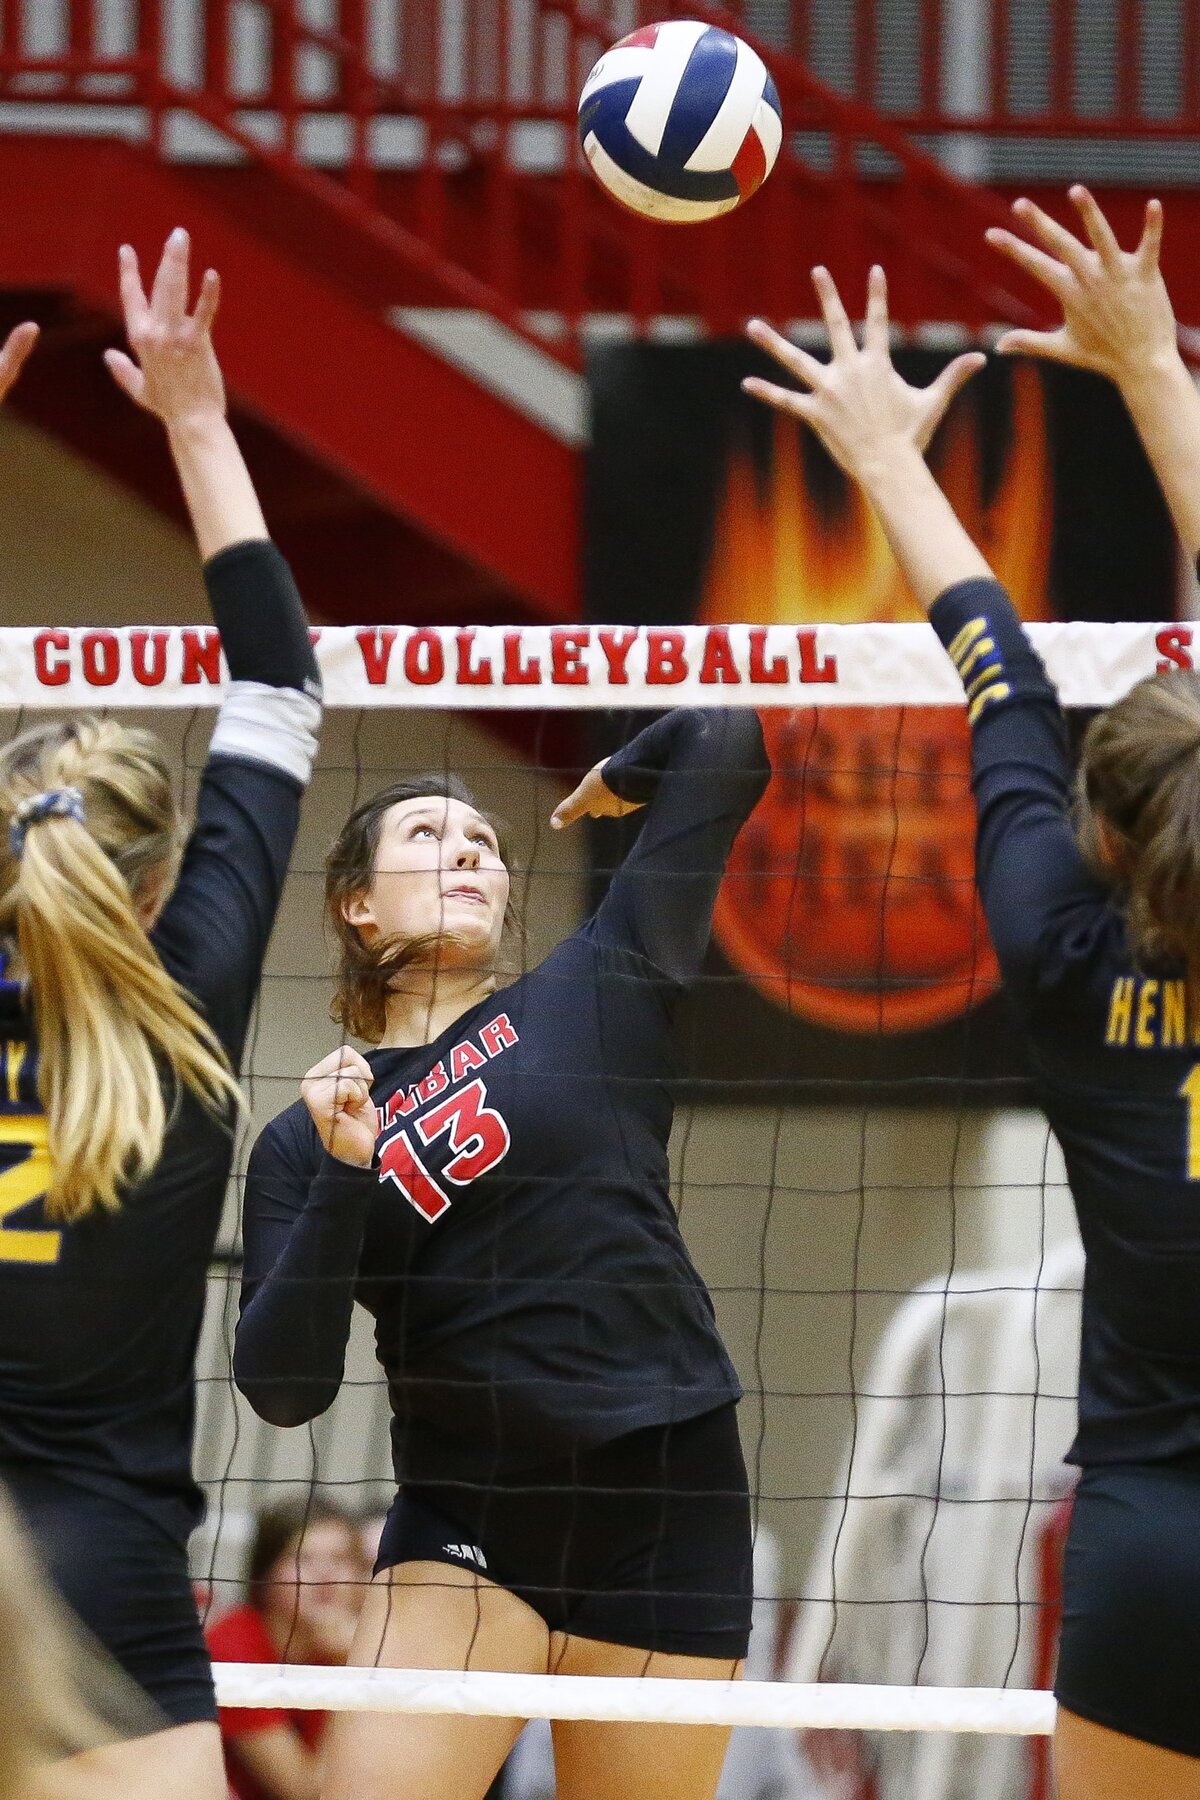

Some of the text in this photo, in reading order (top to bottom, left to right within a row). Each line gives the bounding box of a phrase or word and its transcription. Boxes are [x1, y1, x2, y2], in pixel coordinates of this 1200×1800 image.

[33, 628, 320, 686] COUN
[356, 626, 837, 686] VOLLEYBALL
[1104, 976, 1200, 1048] HEN
[376, 1012, 519, 1139] NBAR
[378, 1077, 512, 1224] 13
